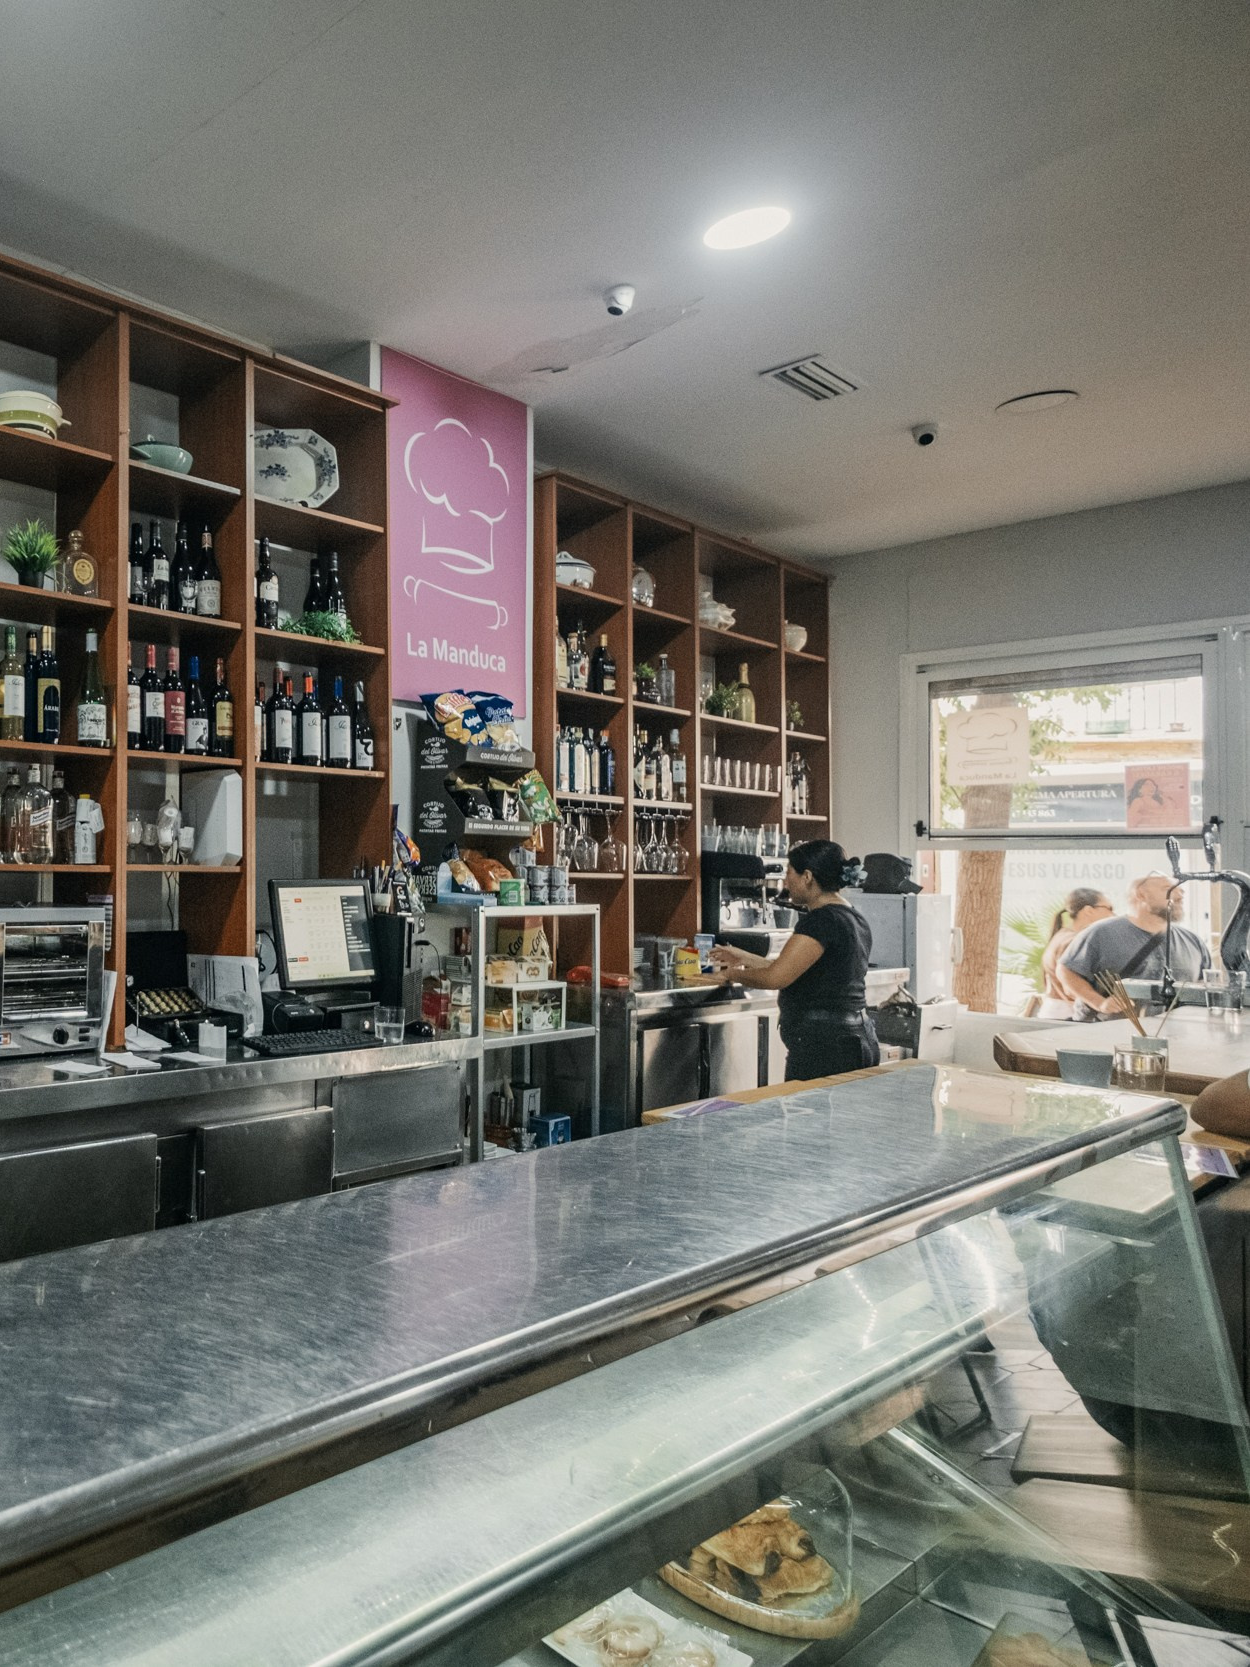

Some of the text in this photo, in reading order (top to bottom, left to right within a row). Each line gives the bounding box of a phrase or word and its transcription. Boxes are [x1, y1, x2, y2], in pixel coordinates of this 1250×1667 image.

[406, 631, 507, 673] La Manduca
[425, 736, 446, 745] CORTIJO
[421, 746, 449, 757] del Olivar
[480, 752, 500, 760] CORTIJO
[499, 752, 508, 761] del
[1057, 789, 1118, 799] APERTURA
[423, 800, 445, 808] CORTIJO
[473, 822, 494, 830] SEGUNDO
[1006, 861, 1125, 879] ESUS VELASCO
